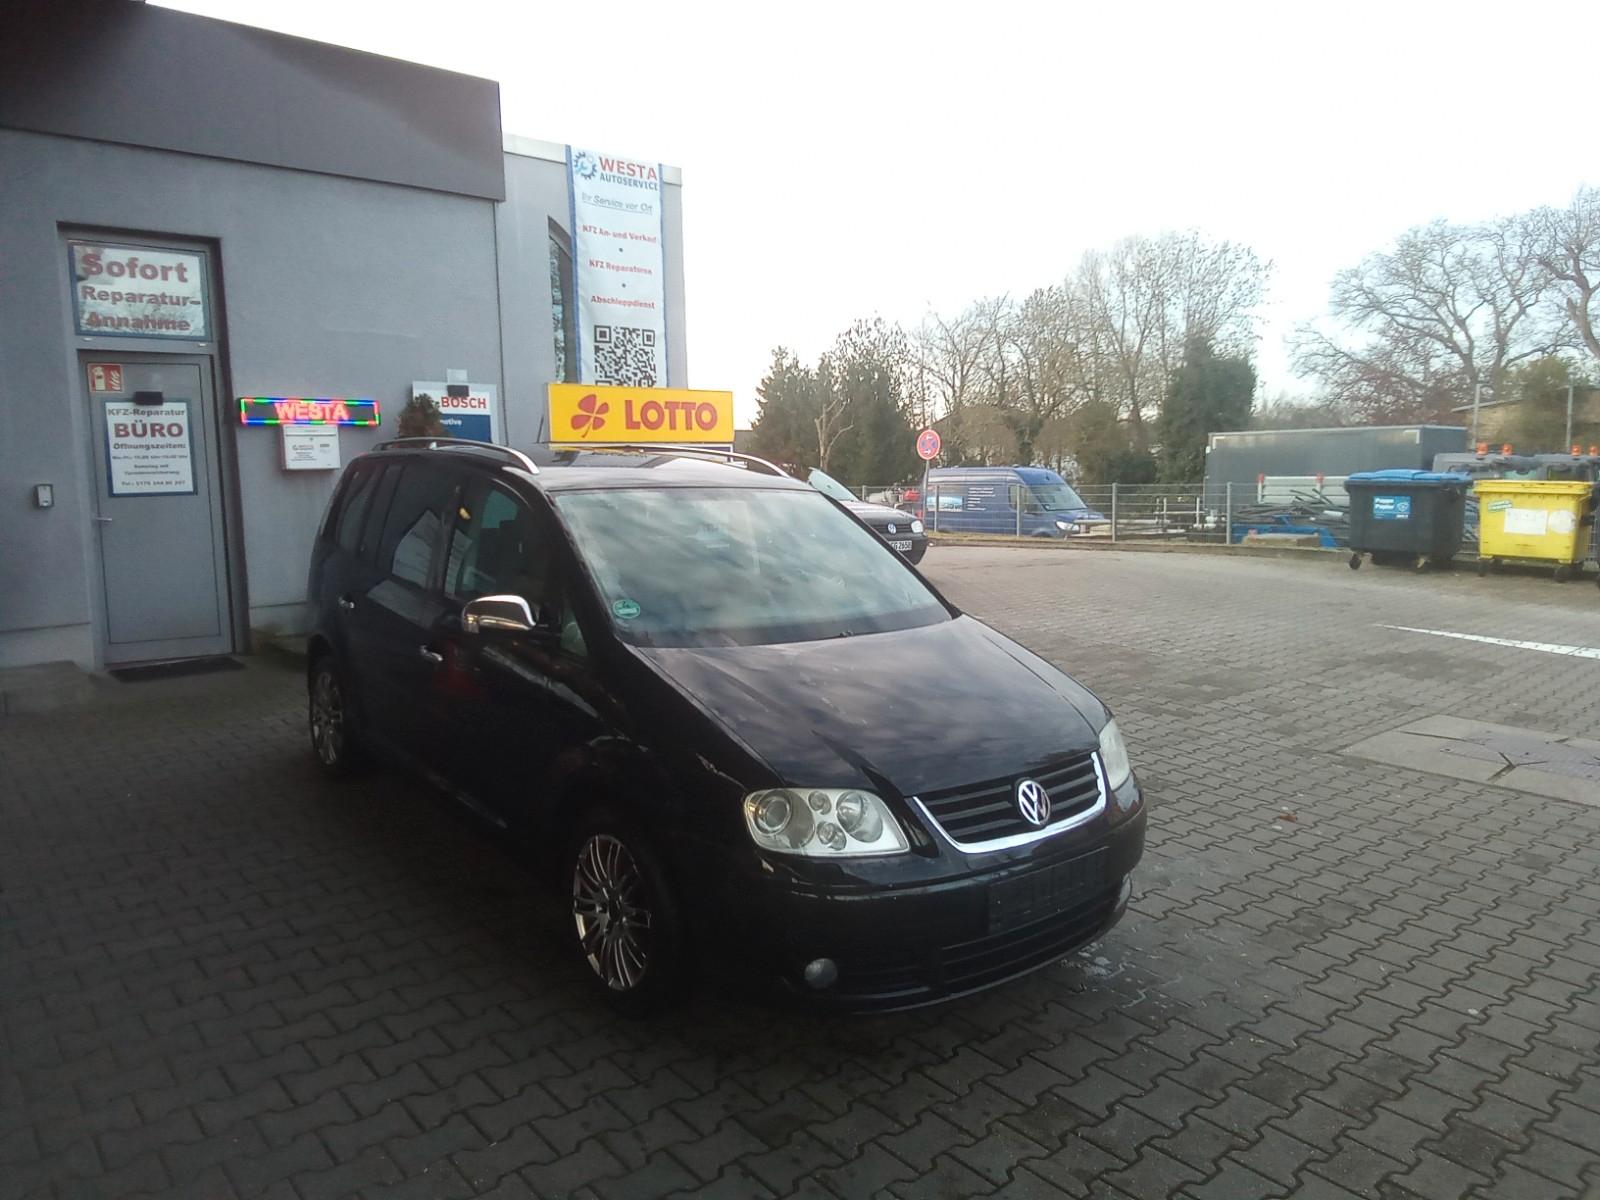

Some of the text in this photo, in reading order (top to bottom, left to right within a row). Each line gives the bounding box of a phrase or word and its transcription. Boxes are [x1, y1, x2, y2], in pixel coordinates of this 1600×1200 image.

[599, 156, 658, 181] WESTA
[600, 172, 658, 191] AUTOSERVICE
[593, 195, 624, 208] Service
[583, 224, 598, 234] KFZ
[612, 231, 627, 239] und
[81, 253, 189, 284] Sofort
[589, 259, 605, 269] KFZ
[81, 285, 202, 306] Reparatur-
[591, 295, 656, 309] Abschleppdienst
[86, 311, 192, 331] Annahme
[273, 401, 350, 421] WESTA
[440, 396, 487, 409] BOSCH
[107, 408, 186, 417] KFZ-Reparatur
[624, 399, 718, 431] LOTTO
[113, 419, 184, 438] BÜRO
